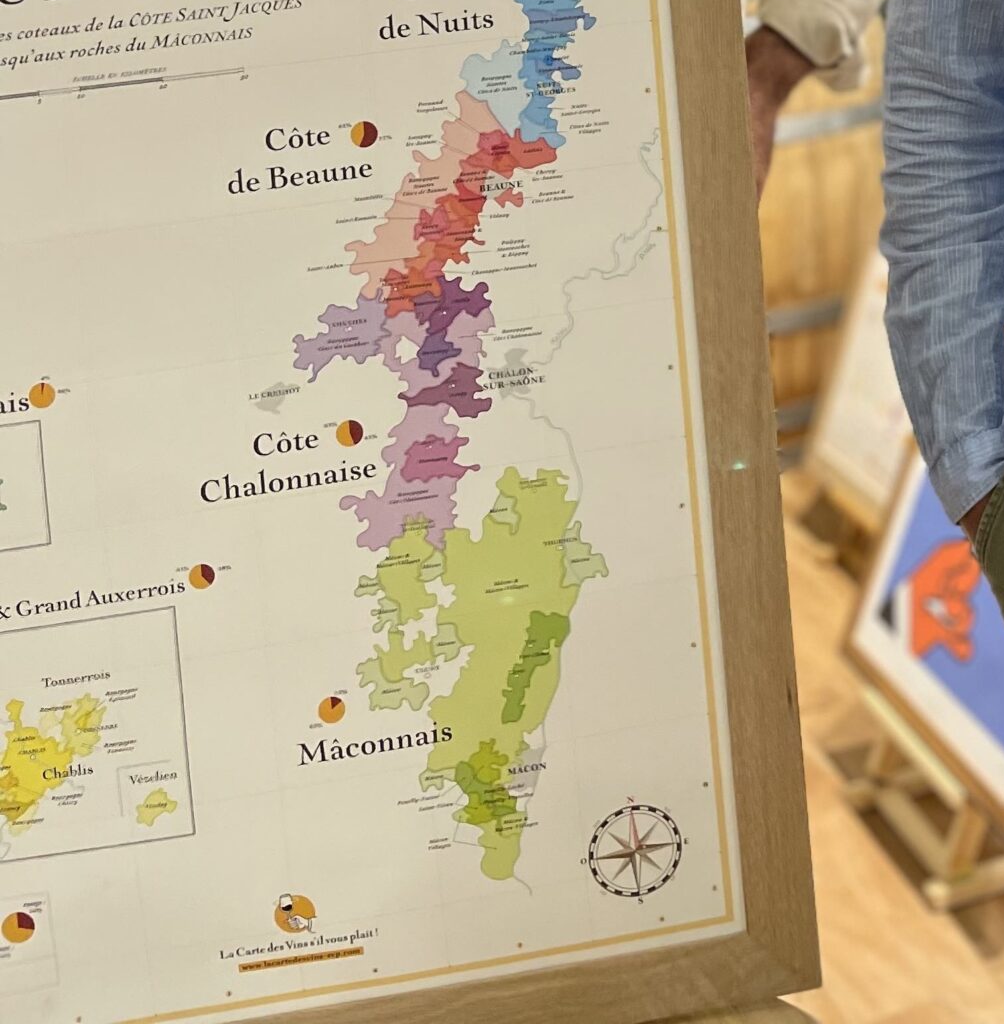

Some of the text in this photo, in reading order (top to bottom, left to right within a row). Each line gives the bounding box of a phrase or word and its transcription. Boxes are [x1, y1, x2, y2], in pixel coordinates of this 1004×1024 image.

[16, 23, 81, 41] coteaux
[85, 16, 104, 33] de
[108, 14, 124, 30] la
[129, 8, 173, 28] CÔTE
[176, 5, 226, 24] SAINT
[379, 9, 495, 40] de Nuits
[69, 41, 121, 60] roches
[125, 35, 147, 53] du
[149, 26, 254, 51] MÂCONNAIS
[265, 127, 331, 152] Côte
[228, 162, 374, 195] de Beaune
[479, 179, 524, 193] BEAUNE
[253, 431, 320, 457] Côte
[200, 460, 377, 502] Chalonnaise
[16, 591, 82, 617] Grand
[85, 578, 186, 607] Auxerrois
[41, 670, 111, 689] Tonnerrois
[297, 721, 453, 766] Mâconnais
[42, 763, 94, 781] Chablis
[219, 950, 234, 960] La
[236, 946, 266, 958] Carte
[267, 941, 285, 954] des
[285, 939, 309, 951] Vins
[309, 935, 324, 947] s'il
[325, 935, 349, 944] vous
